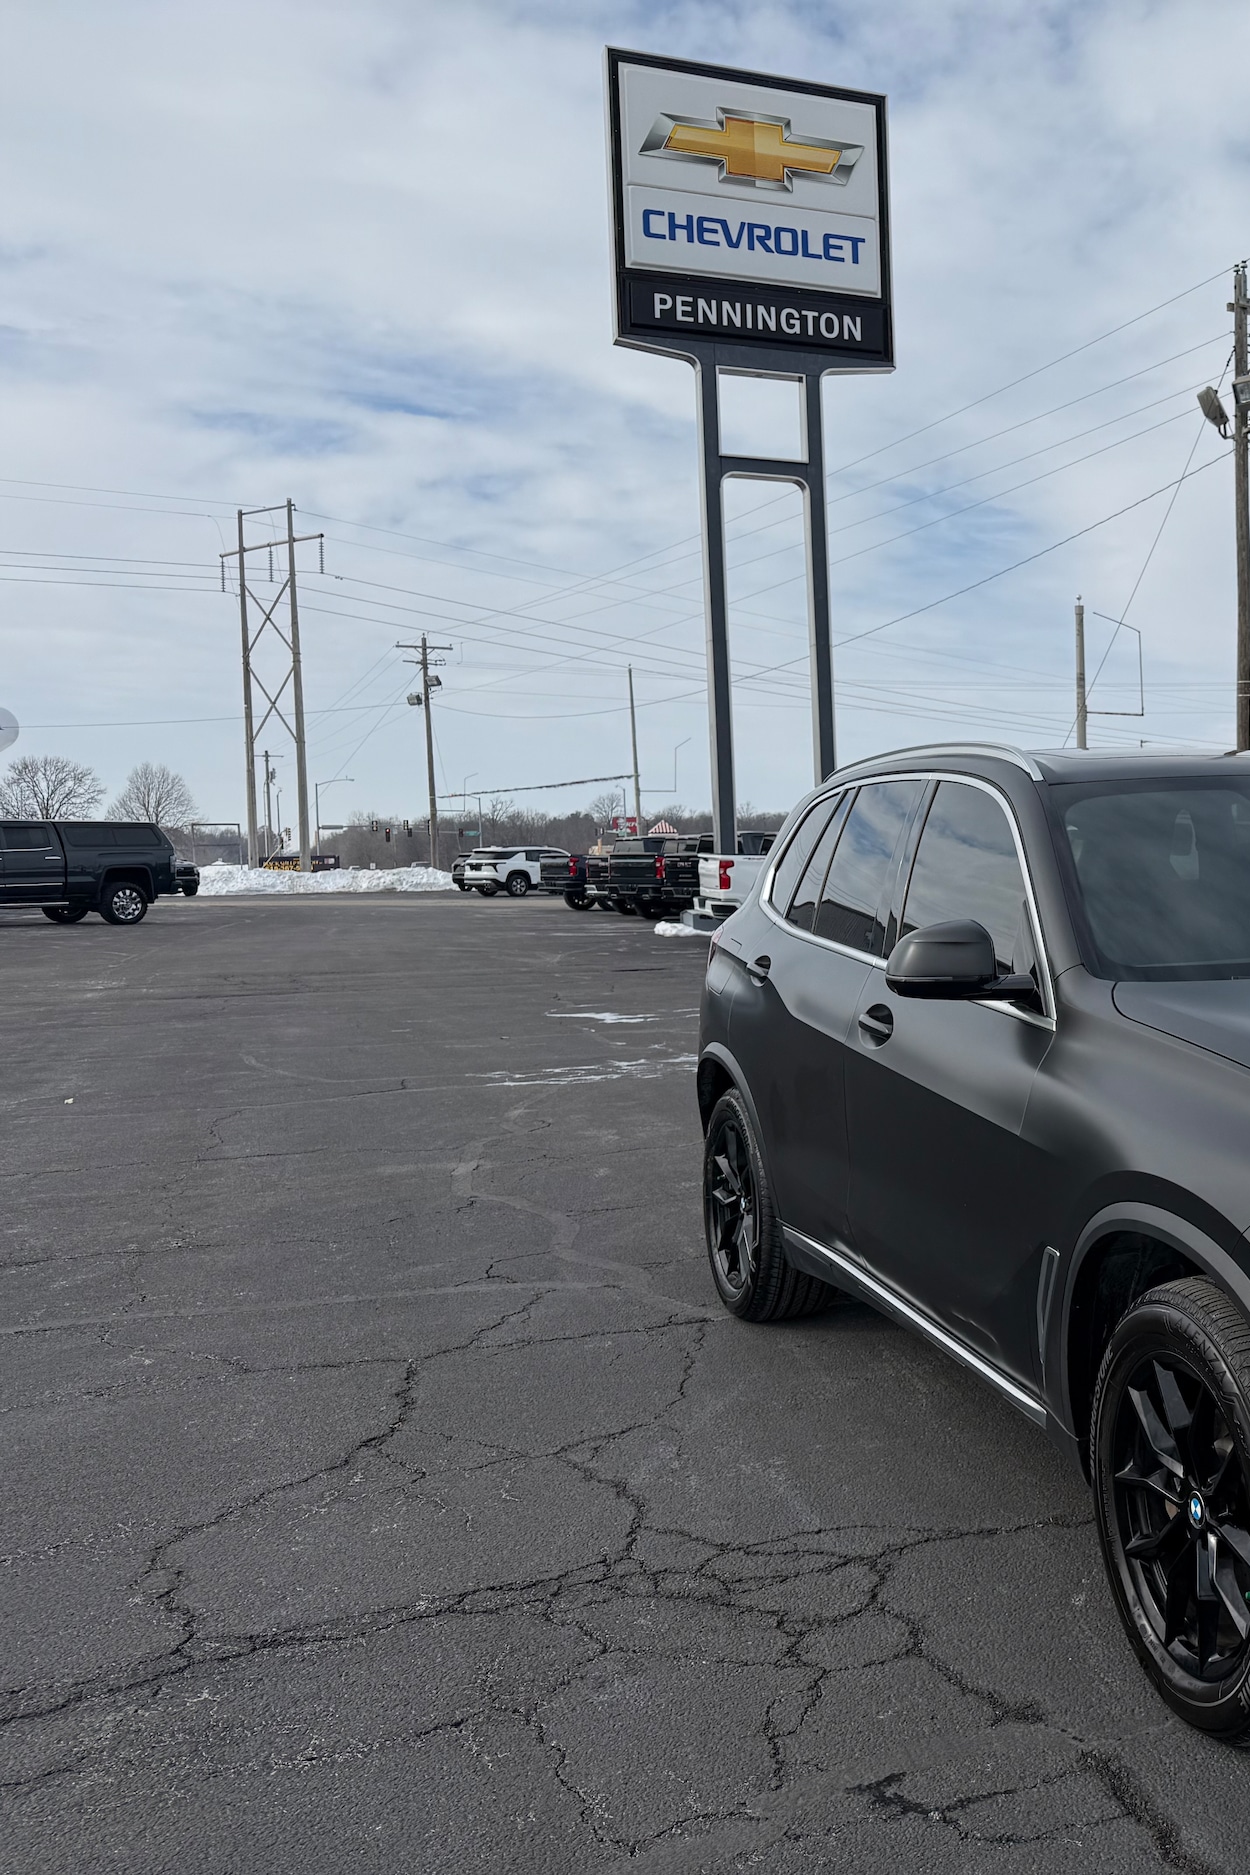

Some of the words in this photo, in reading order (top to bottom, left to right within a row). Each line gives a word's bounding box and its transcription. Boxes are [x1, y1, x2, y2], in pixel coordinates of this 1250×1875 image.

[642, 208, 866, 265] CHEVROLET
[653, 292, 863, 342] PENNINGTON
[1175, 1317, 1227, 1386] ALENZA
